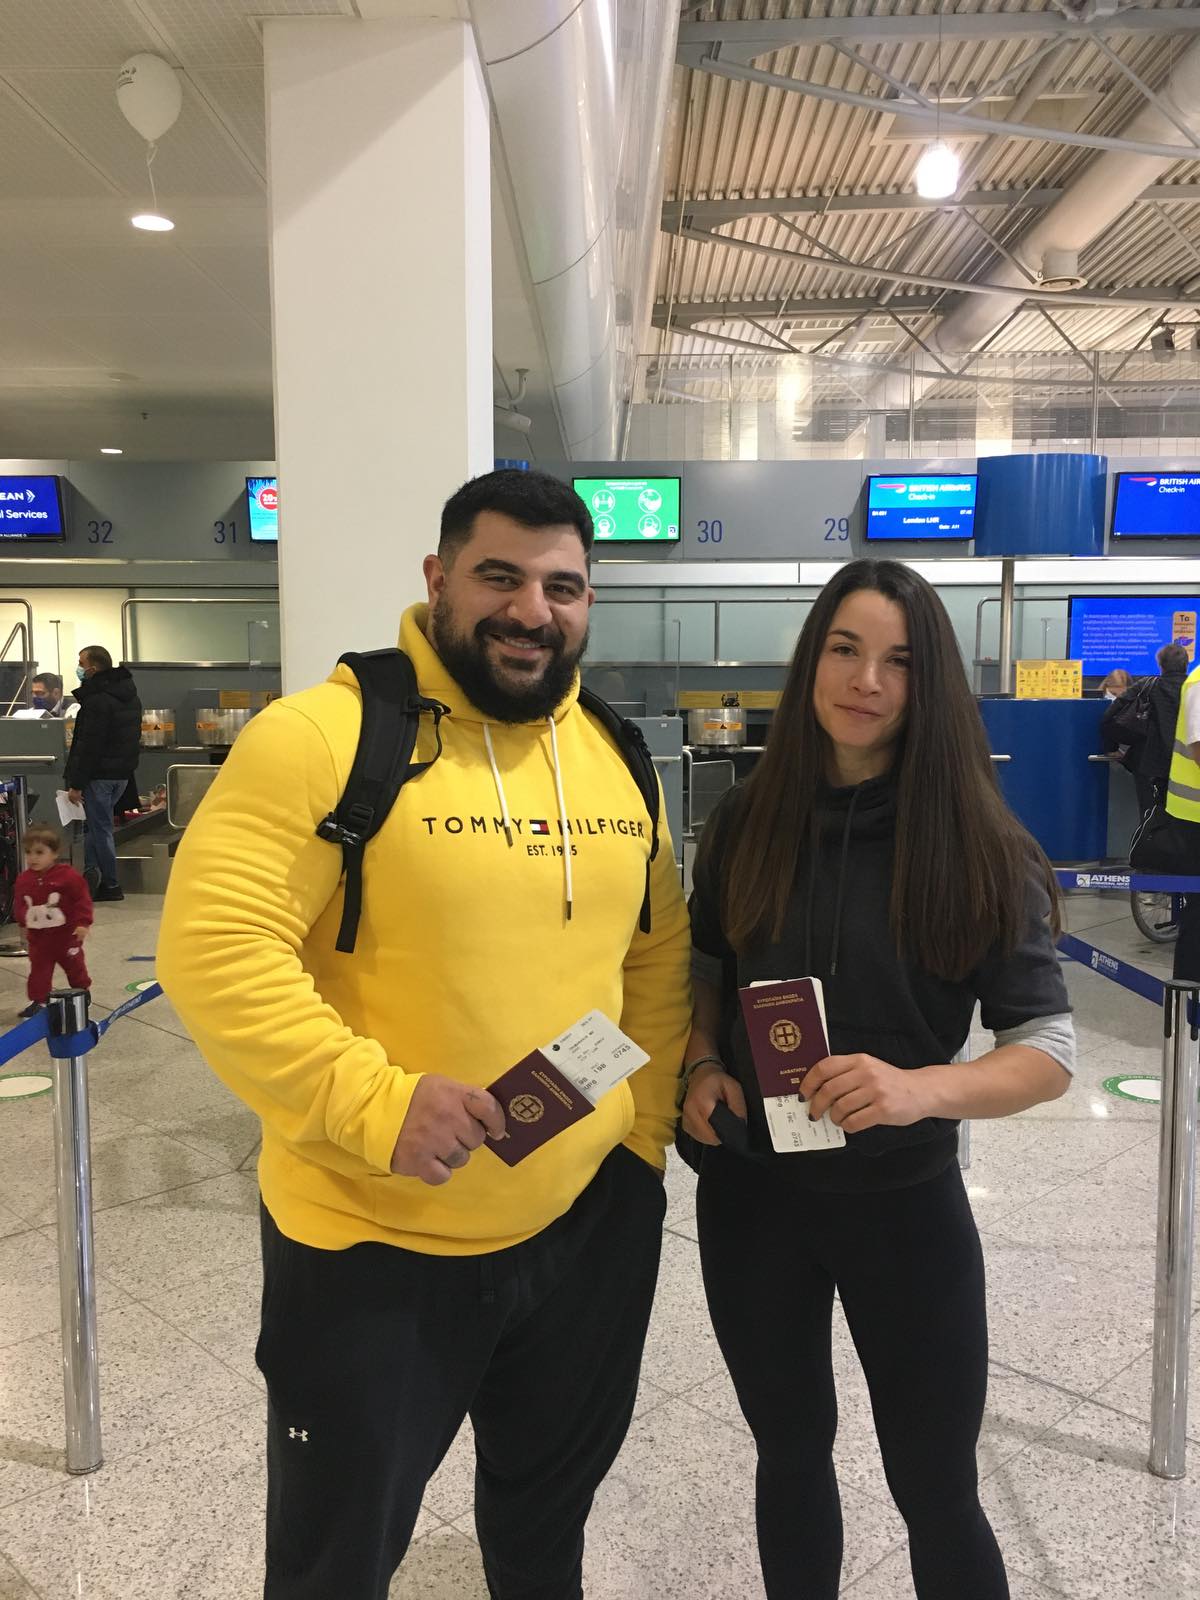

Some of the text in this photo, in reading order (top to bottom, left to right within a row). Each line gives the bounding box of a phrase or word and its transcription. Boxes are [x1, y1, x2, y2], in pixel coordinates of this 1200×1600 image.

[5, 509, 48, 519] Services
[87, 520, 114, 544] 32
[214, 520, 236, 544] 31
[697, 520, 723, 543] 30
[824, 518, 849, 541] 29
[422, 816, 645, 839] TOMMY HILFIGER
[526, 845, 578, 857] EST. 195
[1091, 874, 1131, 883] ATHENS
